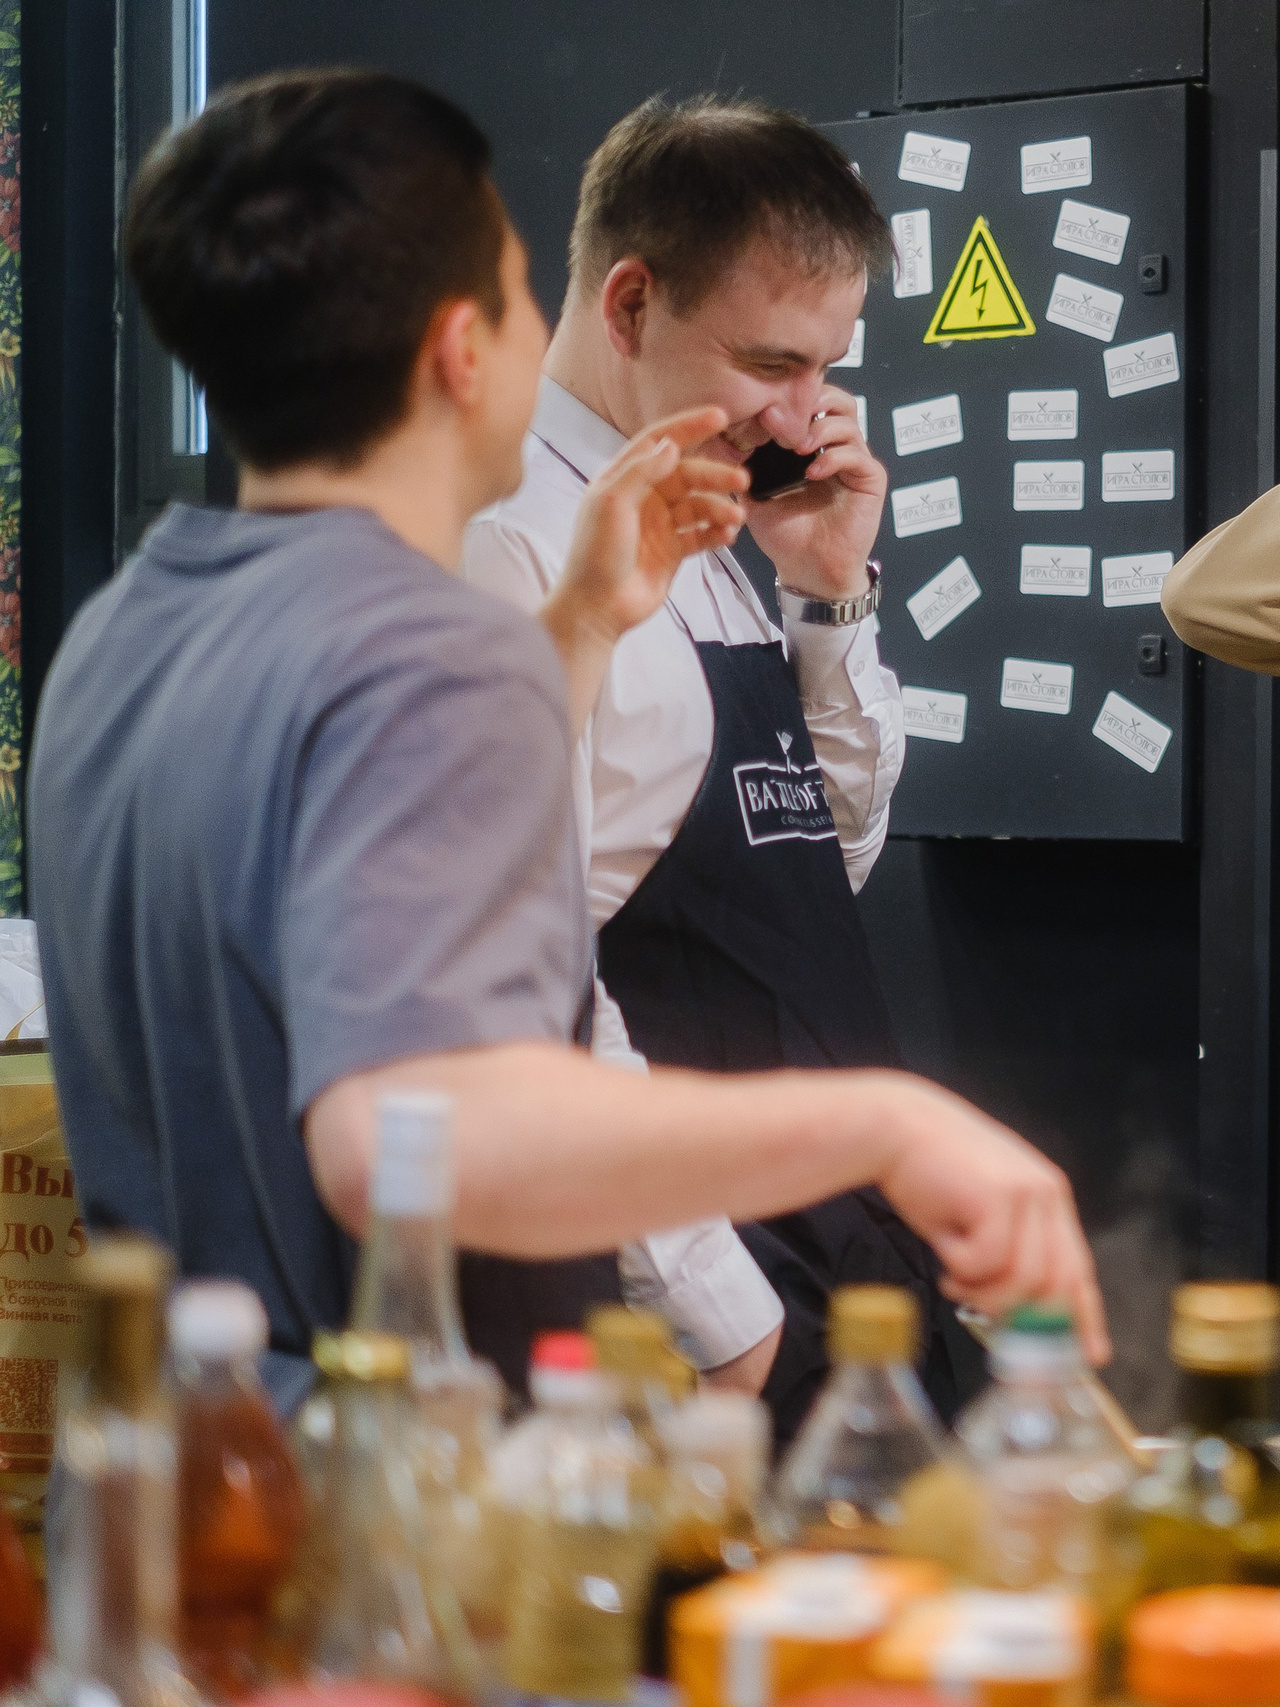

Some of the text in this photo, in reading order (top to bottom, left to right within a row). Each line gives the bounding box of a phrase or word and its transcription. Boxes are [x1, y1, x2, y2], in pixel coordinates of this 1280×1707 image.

[1111, 366, 1133, 380] ИГРА
[1107, 475, 1129, 485] ИГРА
[1019, 484, 1040, 494] ИГРА
[1025, 568, 1047, 578] ИГРА
[1131, 576, 1165, 588] СТОЛО
[1007, 682, 1029, 693] ИГРА
[1103, 714, 1123, 734] ИГРА
